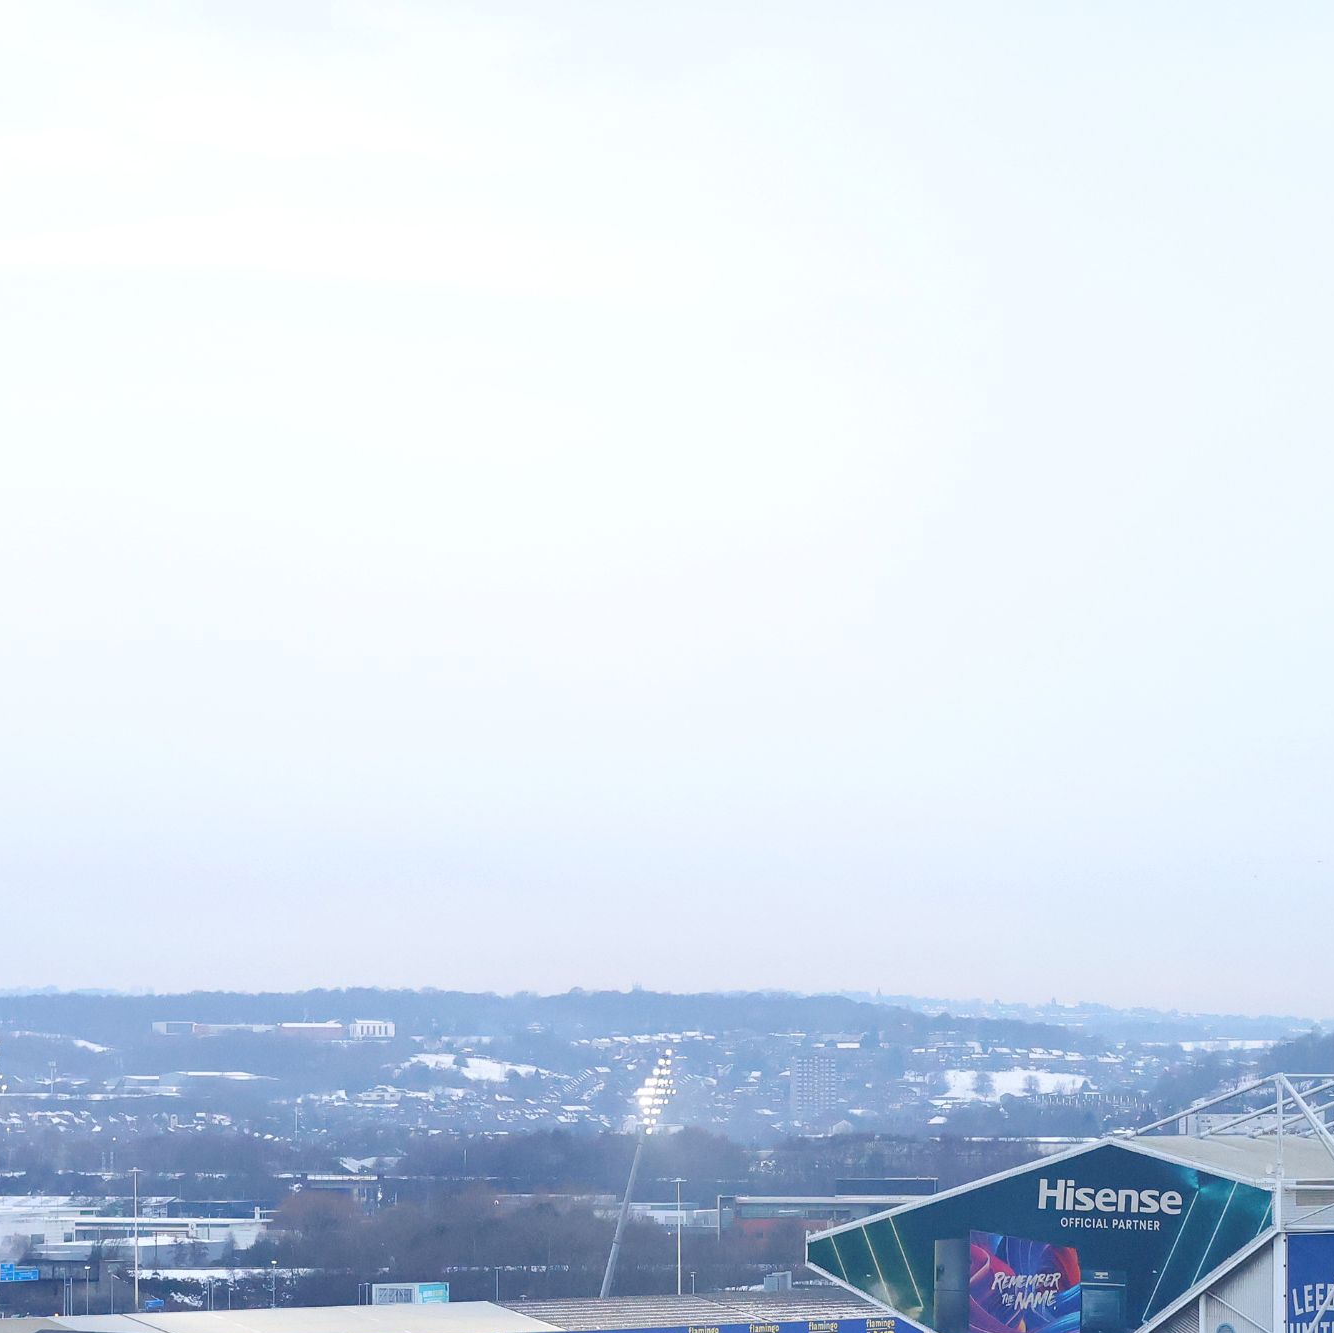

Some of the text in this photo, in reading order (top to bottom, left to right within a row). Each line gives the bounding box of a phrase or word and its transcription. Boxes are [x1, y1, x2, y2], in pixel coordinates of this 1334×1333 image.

[1038, 1178, 1183, 1215] Hisense
[1060, 1217, 1161, 1231] OFFICIAL PARTNER
[991, 1271, 1062, 1294] REMEMBER
[1002, 1293, 1015, 1307] THE
[808, 1321, 838, 1333] flamingo
[865, 1318, 895, 1330] flamingo
